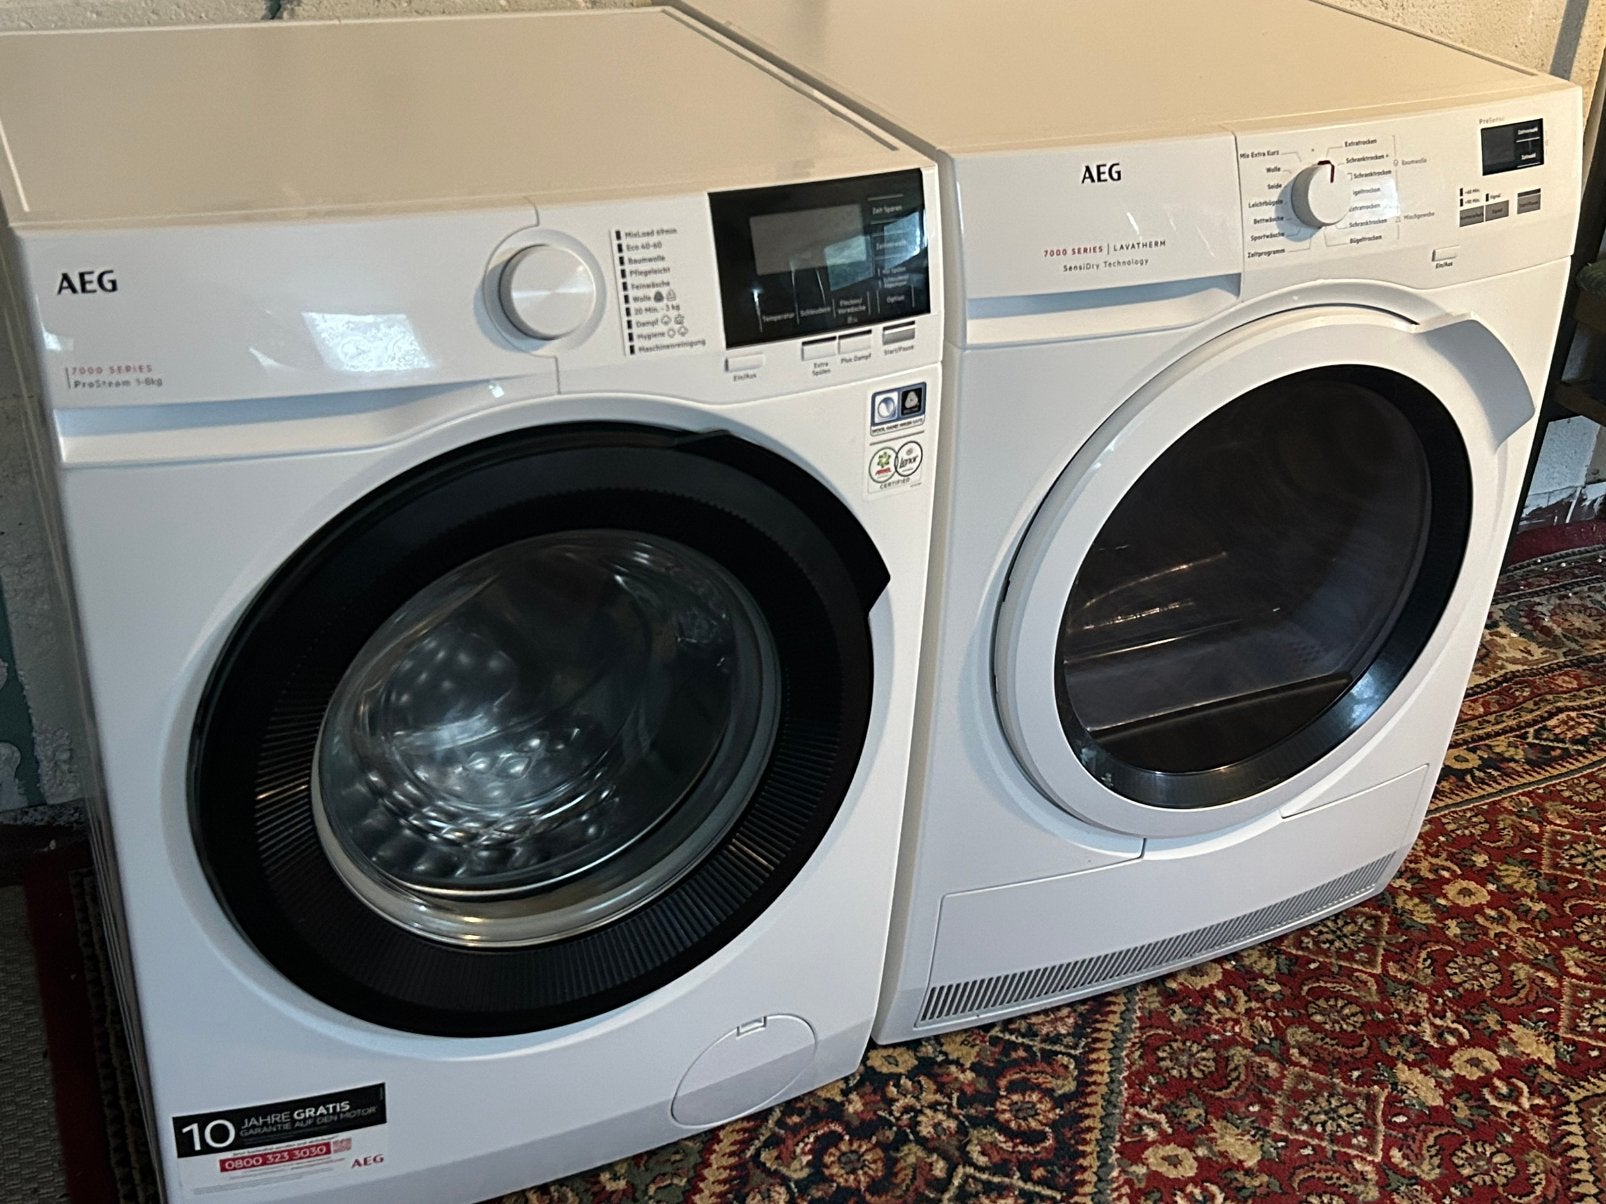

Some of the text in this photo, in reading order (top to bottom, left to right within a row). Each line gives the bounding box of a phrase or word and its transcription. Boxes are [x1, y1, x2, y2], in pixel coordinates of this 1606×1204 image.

[1344, 139, 1377, 148] Extratrocken
[1346, 154, 1385, 164] Schranktrocken
[1081, 162, 1122, 184] AEG
[1353, 170, 1392, 179] Schranktrocken
[1253, 216, 1284, 225] Bettwäsche
[1349, 219, 1387, 228] Schranktrocken
[625, 229, 654, 239] MixLoad
[1250, 232, 1285, 242] Sportwäsche
[1349, 235, 1382, 244] Bügeltrocken
[626, 241, 662, 252] Eco 40-60
[1043, 240, 1166, 258] 7000 SERIES LAVATHERM
[1248, 248, 1285, 259] Zeitprogramm
[628, 255, 666, 265] Baumwolle
[1063, 258, 1149, 273] SensiDry Technology
[630, 267, 671, 277] Pflegeleicht
[57, 269, 118, 295] AEG
[631, 280, 670, 290] Feinwäsche
[633, 295, 651, 303] Wolle
[636, 319, 659, 328] Dampf
[637, 331, 665, 341] Hygiene
[638, 339, 706, 353] Maschinenreinigung
[853, 353, 872, 362] Dampf
[72, 364, 153, 375] 7000 SERIES
[814, 361, 828, 369] Extra
[733, 373, 757, 382] Ein/Aus
[74, 379, 131, 389] ProSteam
[181, 1119, 236, 1151] 10
[241, 1111, 291, 1129] JAHRE
[293, 1100, 350, 1120] GRATIS
[239, 1122, 292, 1137] GARANTIE
[294, 1117, 315, 1129] AUF
[316, 1114, 338, 1125] DEN
[224, 1156, 262, 1170] 0800
[267, 1151, 289, 1164] 323
[293, 1145, 327, 1159] 3030
[351, 1154, 384, 1169] AEG
